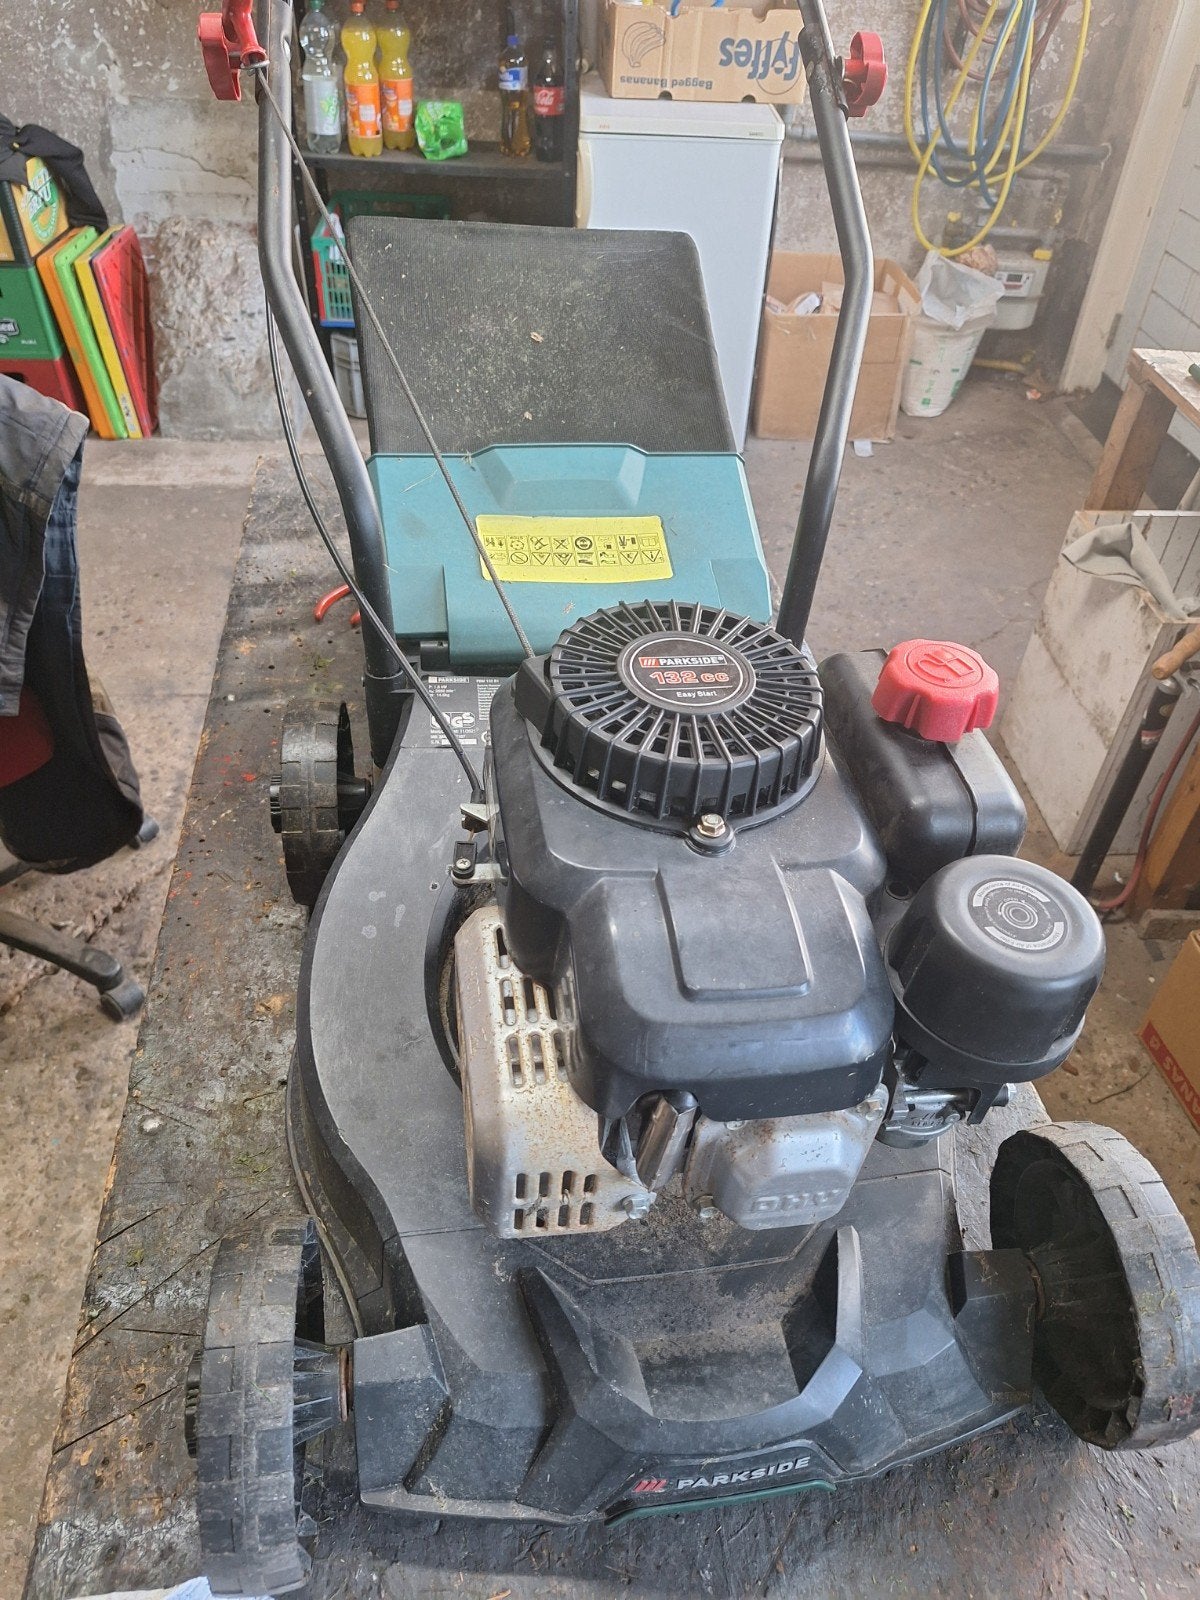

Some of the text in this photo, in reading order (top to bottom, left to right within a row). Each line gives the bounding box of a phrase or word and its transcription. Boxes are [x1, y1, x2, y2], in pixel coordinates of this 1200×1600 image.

[620, 75, 713, 90] Bagged Bananas
[649, 671, 730, 685] 132 cc
[676, 690, 718, 699] Easy Start
[677, 1456, 811, 1490] PARKSIDE
